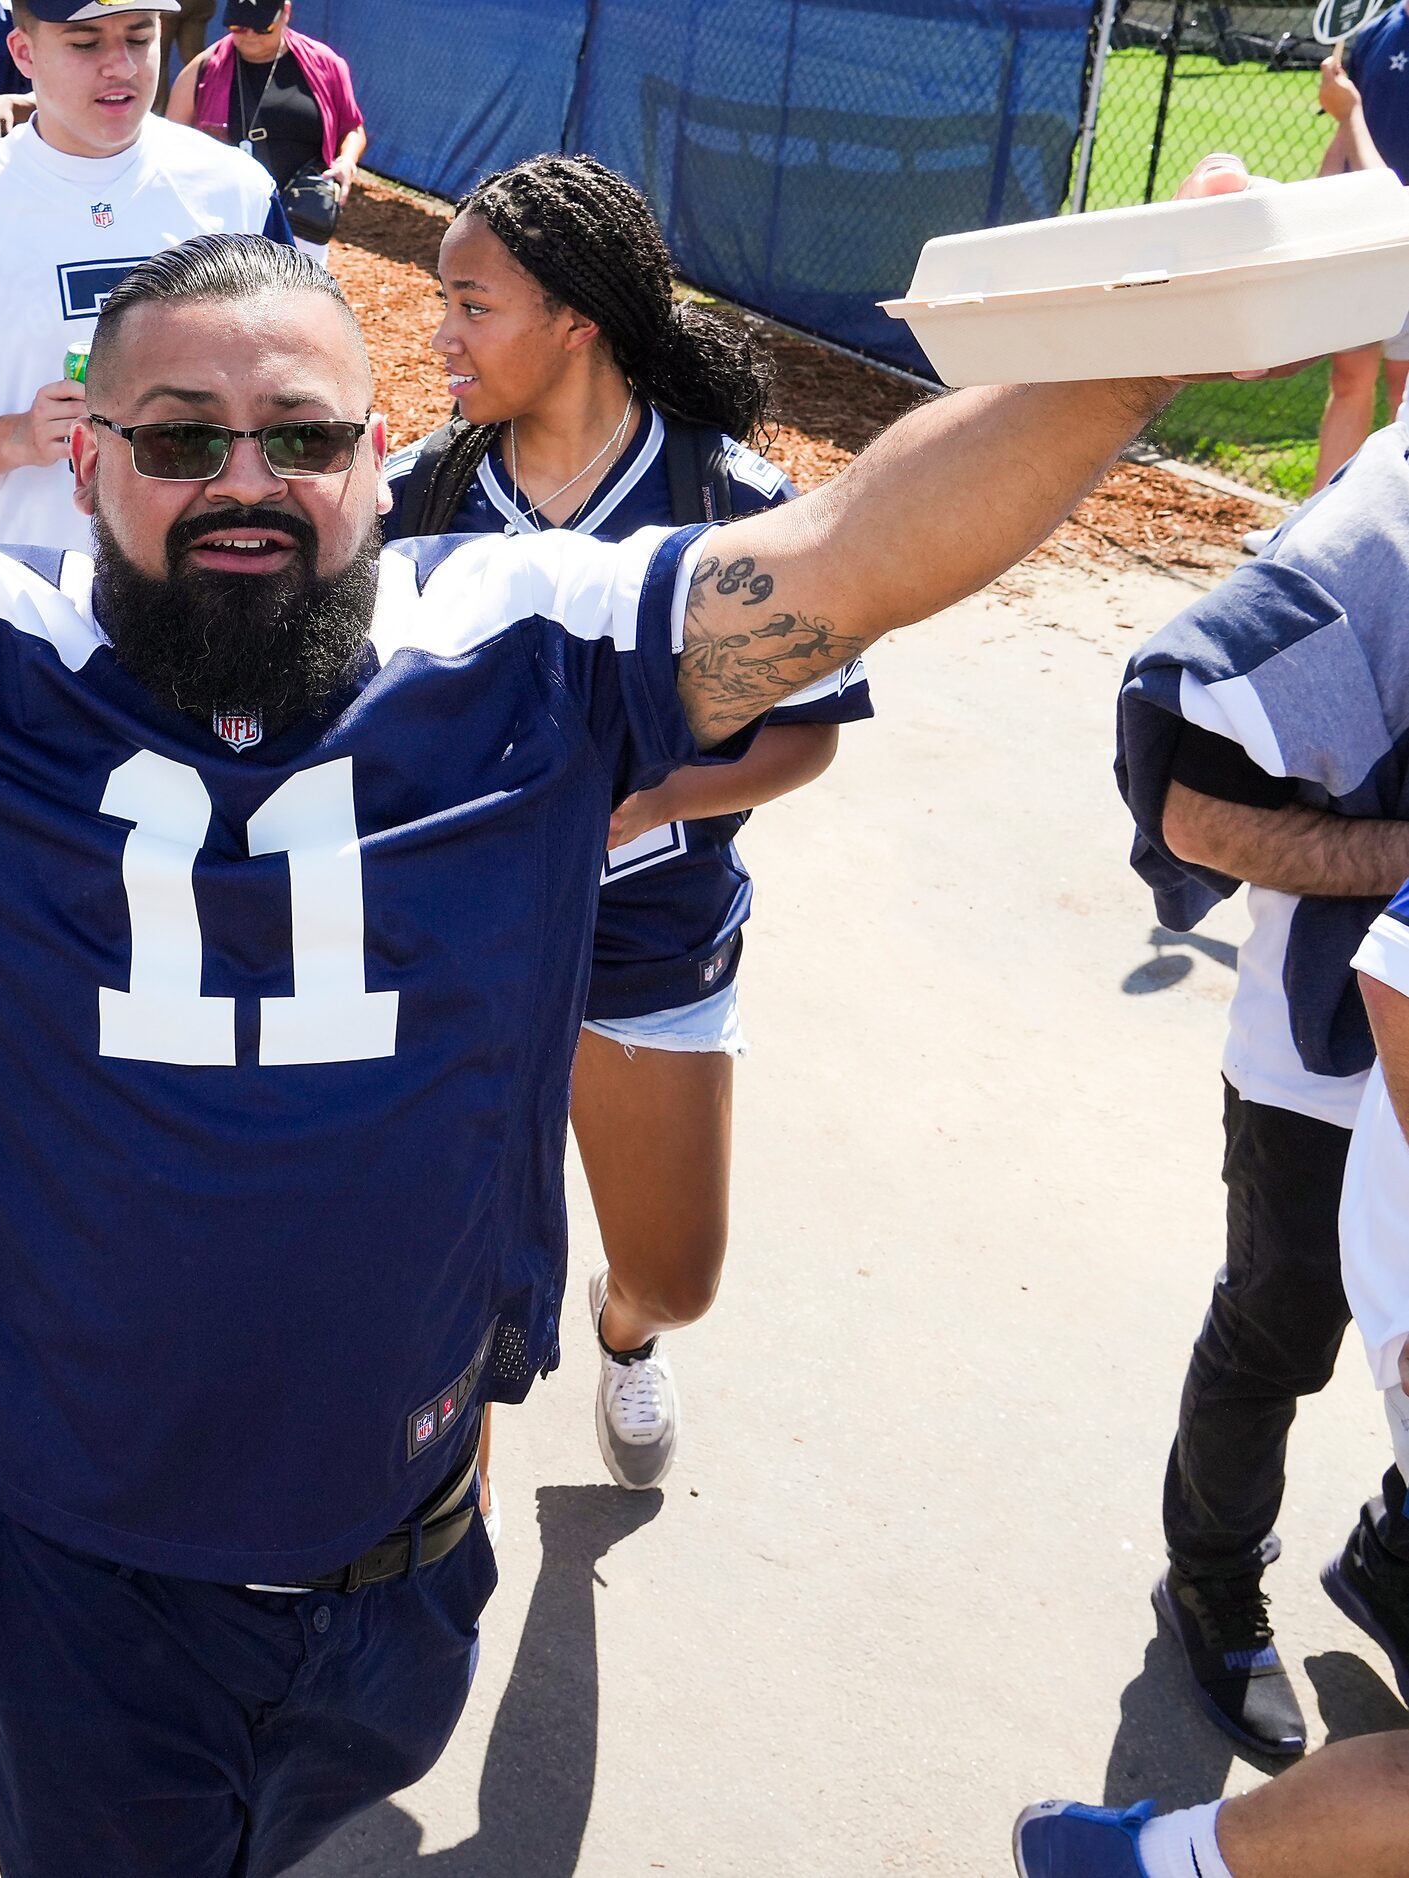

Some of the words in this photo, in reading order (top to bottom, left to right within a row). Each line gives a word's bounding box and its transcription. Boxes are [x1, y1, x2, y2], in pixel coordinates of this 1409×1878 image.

[94, 212, 113, 226] NFL
[221, 717, 256, 742] NFL
[98, 748, 400, 1067] 11
